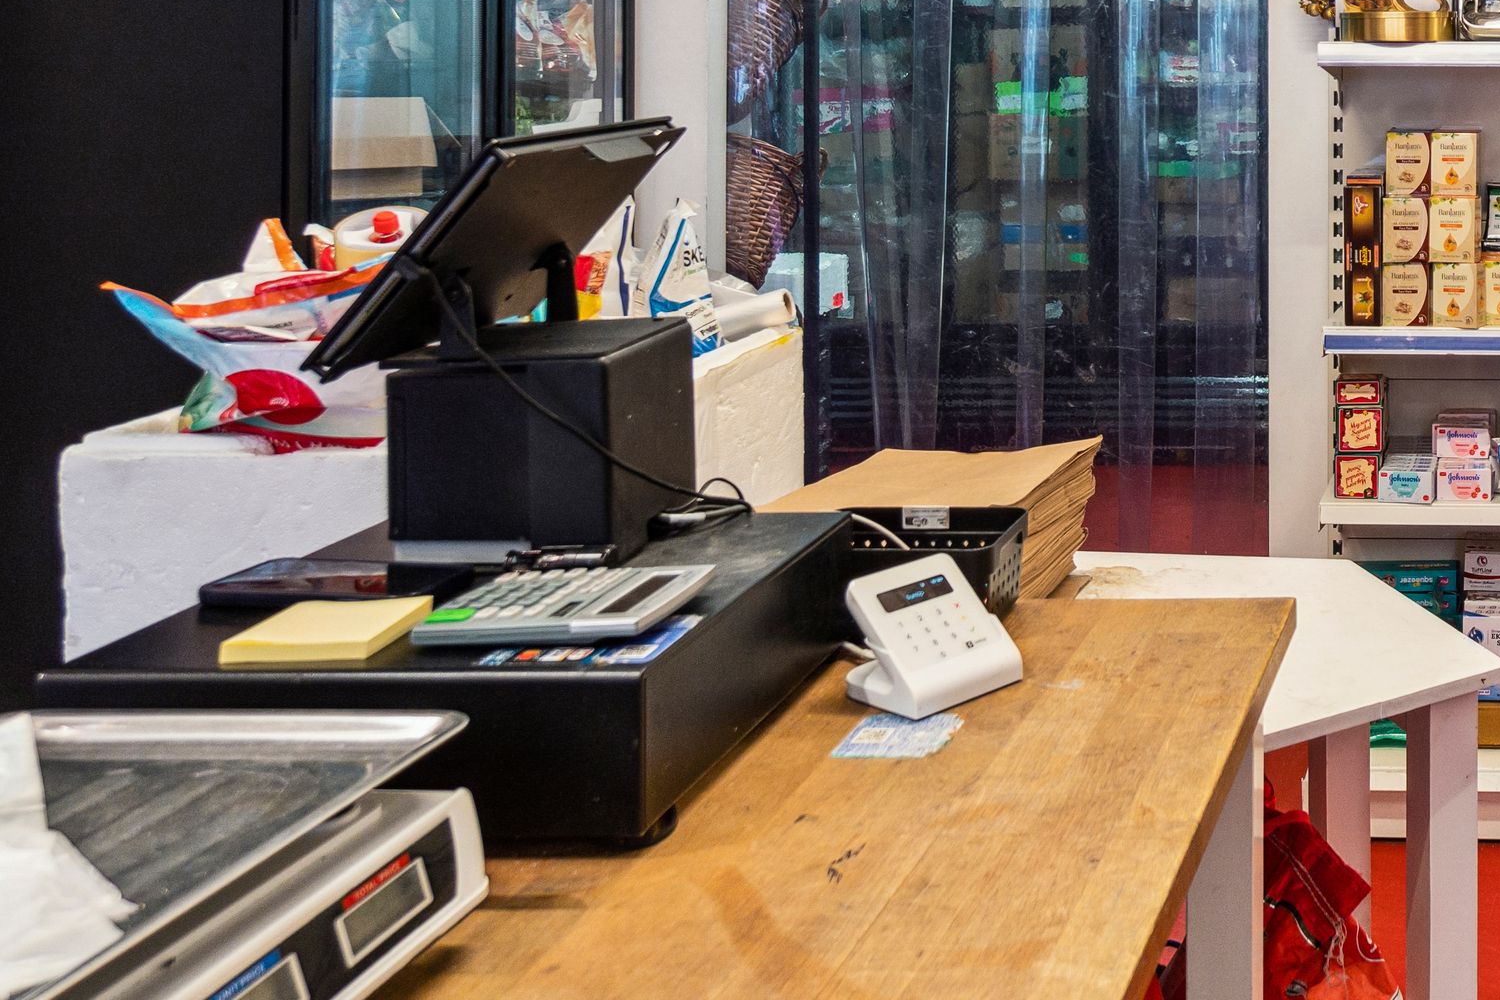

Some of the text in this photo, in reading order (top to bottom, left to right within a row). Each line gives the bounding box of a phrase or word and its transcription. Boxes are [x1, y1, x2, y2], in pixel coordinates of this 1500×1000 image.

[1446, 430, 1478, 441] Johnson's
[1389, 473, 1421, 486] Johnson's
[1448, 472, 1480, 484] Johnson's
[354, 862, 401, 900] TOTAL PRICE
[239, 964, 265, 985] PRICE
